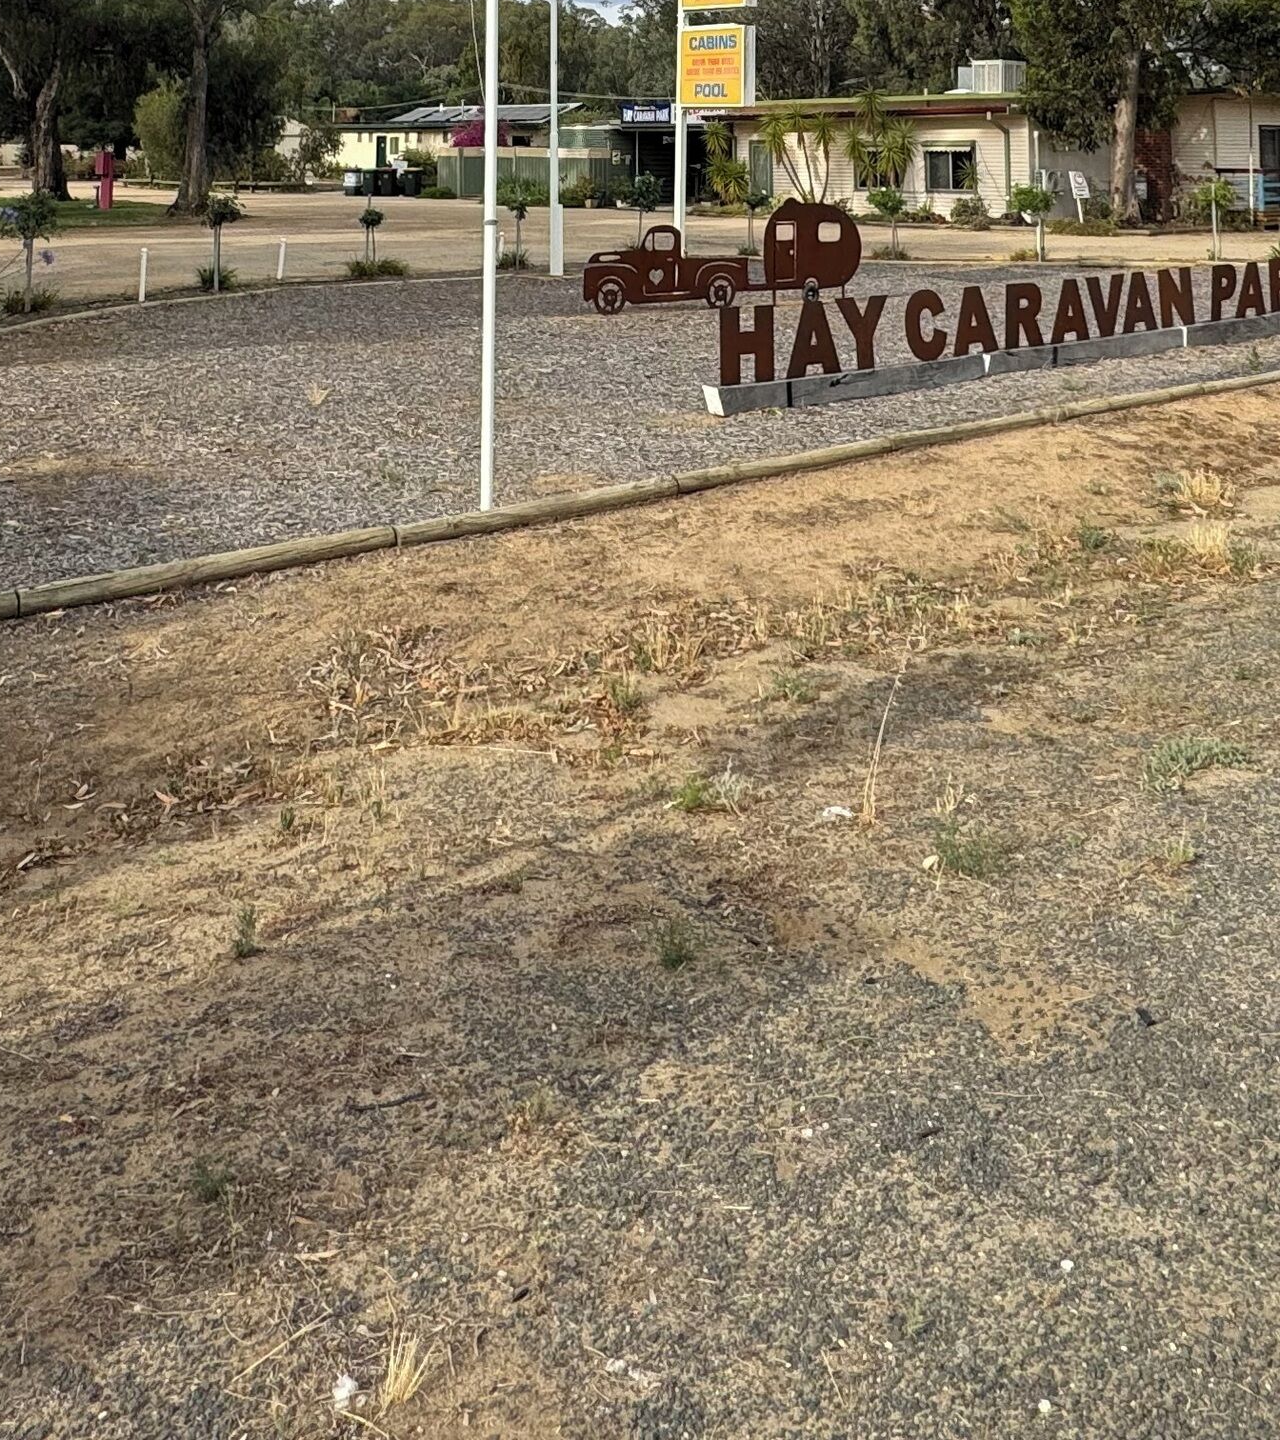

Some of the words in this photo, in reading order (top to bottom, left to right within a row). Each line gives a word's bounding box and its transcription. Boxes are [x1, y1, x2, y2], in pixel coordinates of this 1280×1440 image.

[689, 33, 737, 51] CABINS
[694, 82, 728, 98] POOL
[720, 295, 887, 386] HAY
[904, 266, 1195, 362] CARAVAN
